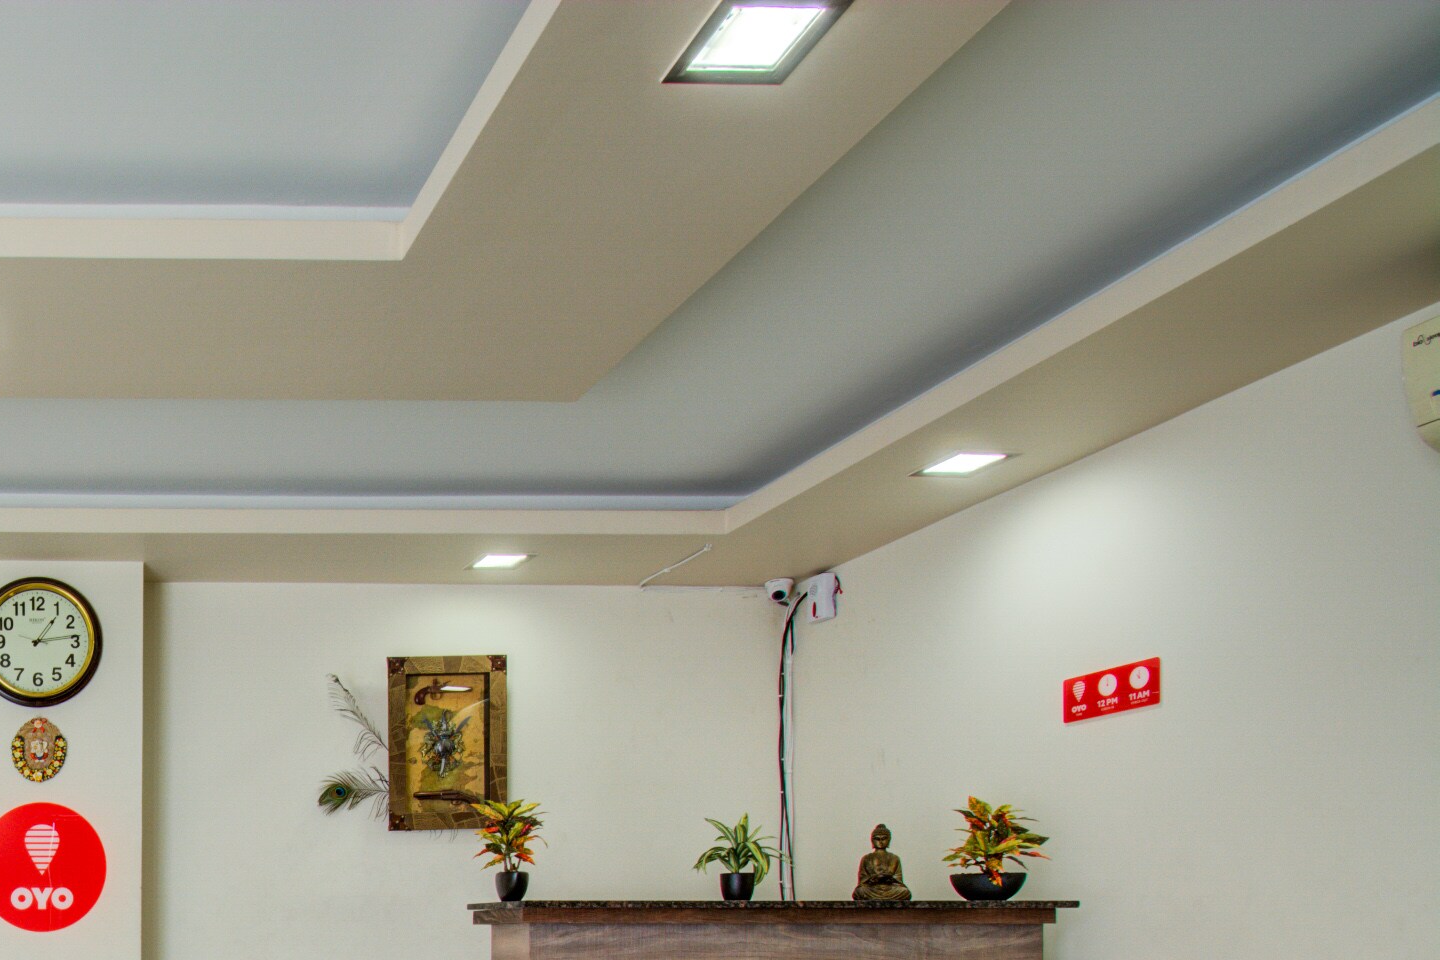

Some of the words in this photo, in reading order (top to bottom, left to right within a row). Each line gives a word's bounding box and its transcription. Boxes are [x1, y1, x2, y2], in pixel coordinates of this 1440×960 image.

[12, 601, 26, 616] 11
[29, 596, 45, 611] 12
[53, 601, 60, 616] 1
[66, 615, 75, 629] 2
[70, 634, 81, 649] 3
[0, 653, 11, 668] 8
[65, 653, 76, 667] 4
[13, 667, 25, 681] 7
[32, 672, 44, 687] 6
[51, 667, 62, 682] 5
[1096, 699, 1106, 708] 12
[1106, 697, 1118, 706] PM
[1128, 692, 1137, 701] 11
[1137, 690, 1150, 700] AM
[1071, 704, 1087, 713] OYO
[10, 886, 74, 911] OYO
